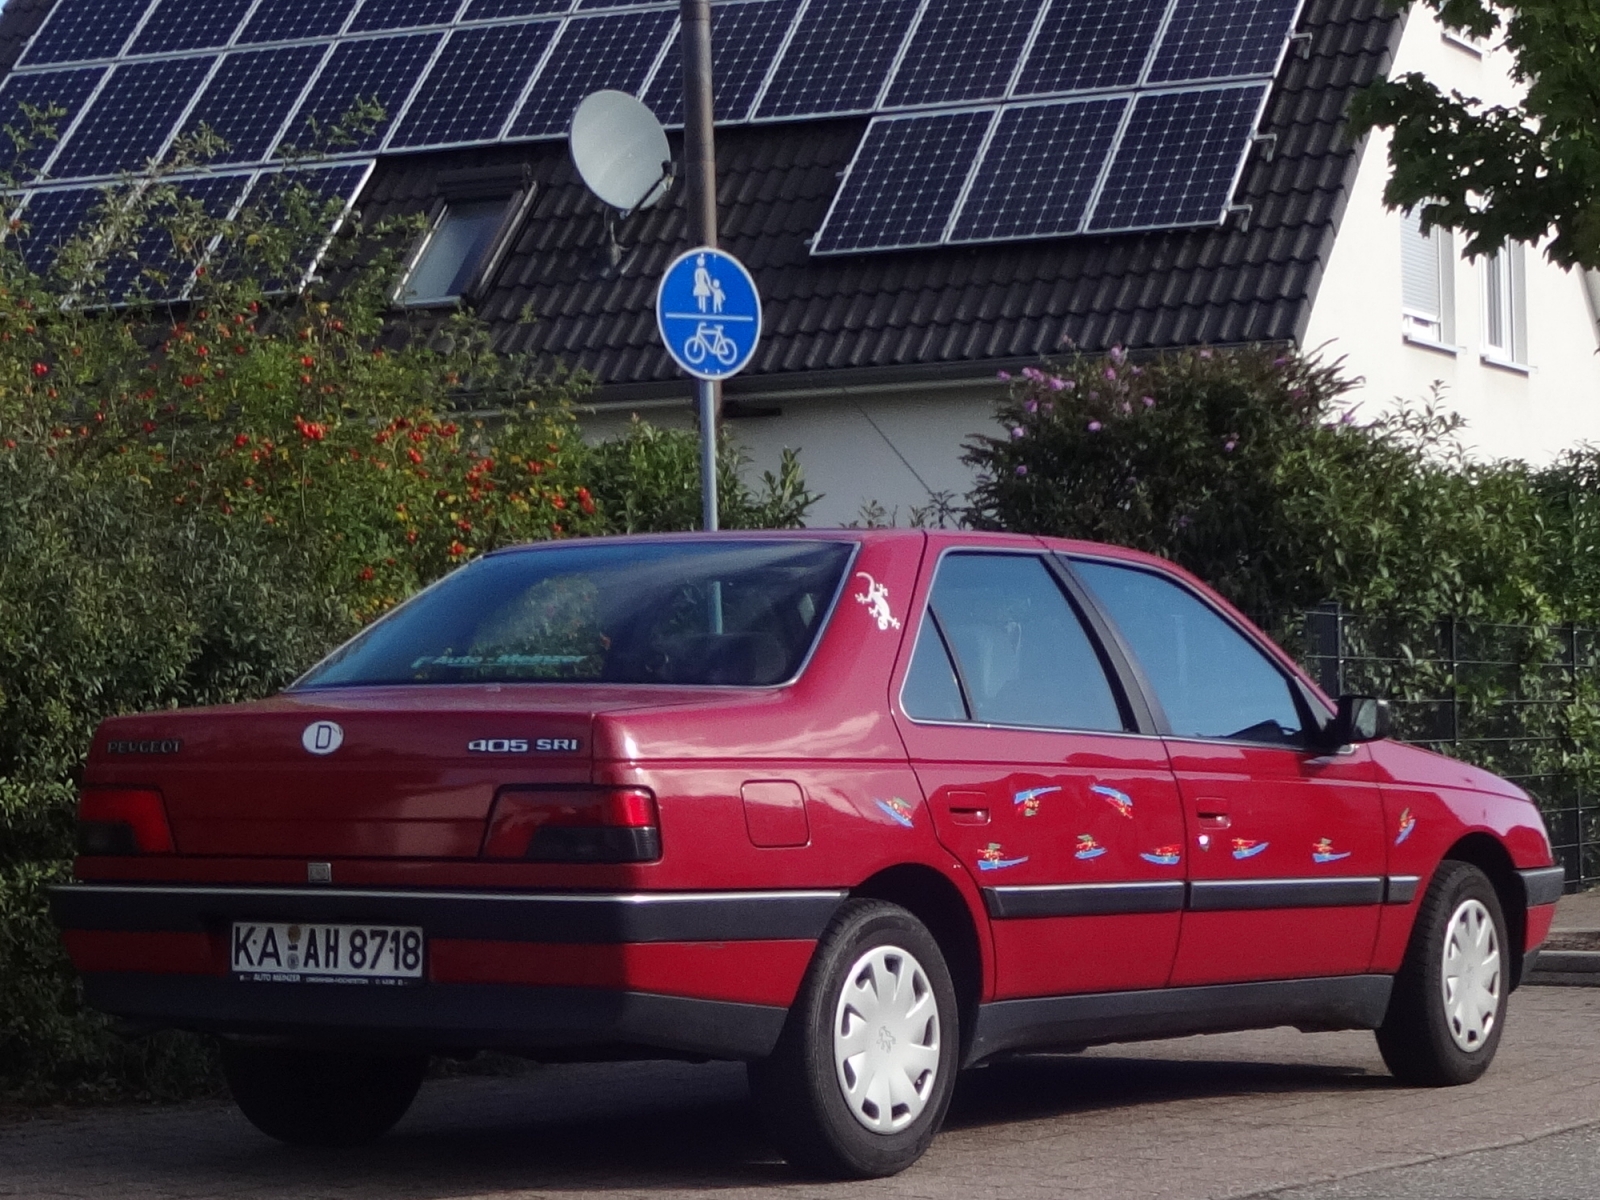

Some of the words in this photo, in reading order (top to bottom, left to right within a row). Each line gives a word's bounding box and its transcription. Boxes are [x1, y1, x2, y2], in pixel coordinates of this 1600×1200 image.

[107, 740, 181, 754] PEUGEOT
[315, 724, 332, 750] D
[468, 739, 529, 752] 405
[535, 738, 578, 751] SRI
[234, 926, 282, 967] KA
[303, 927, 340, 969] AH
[349, 929, 421, 971] 8718
